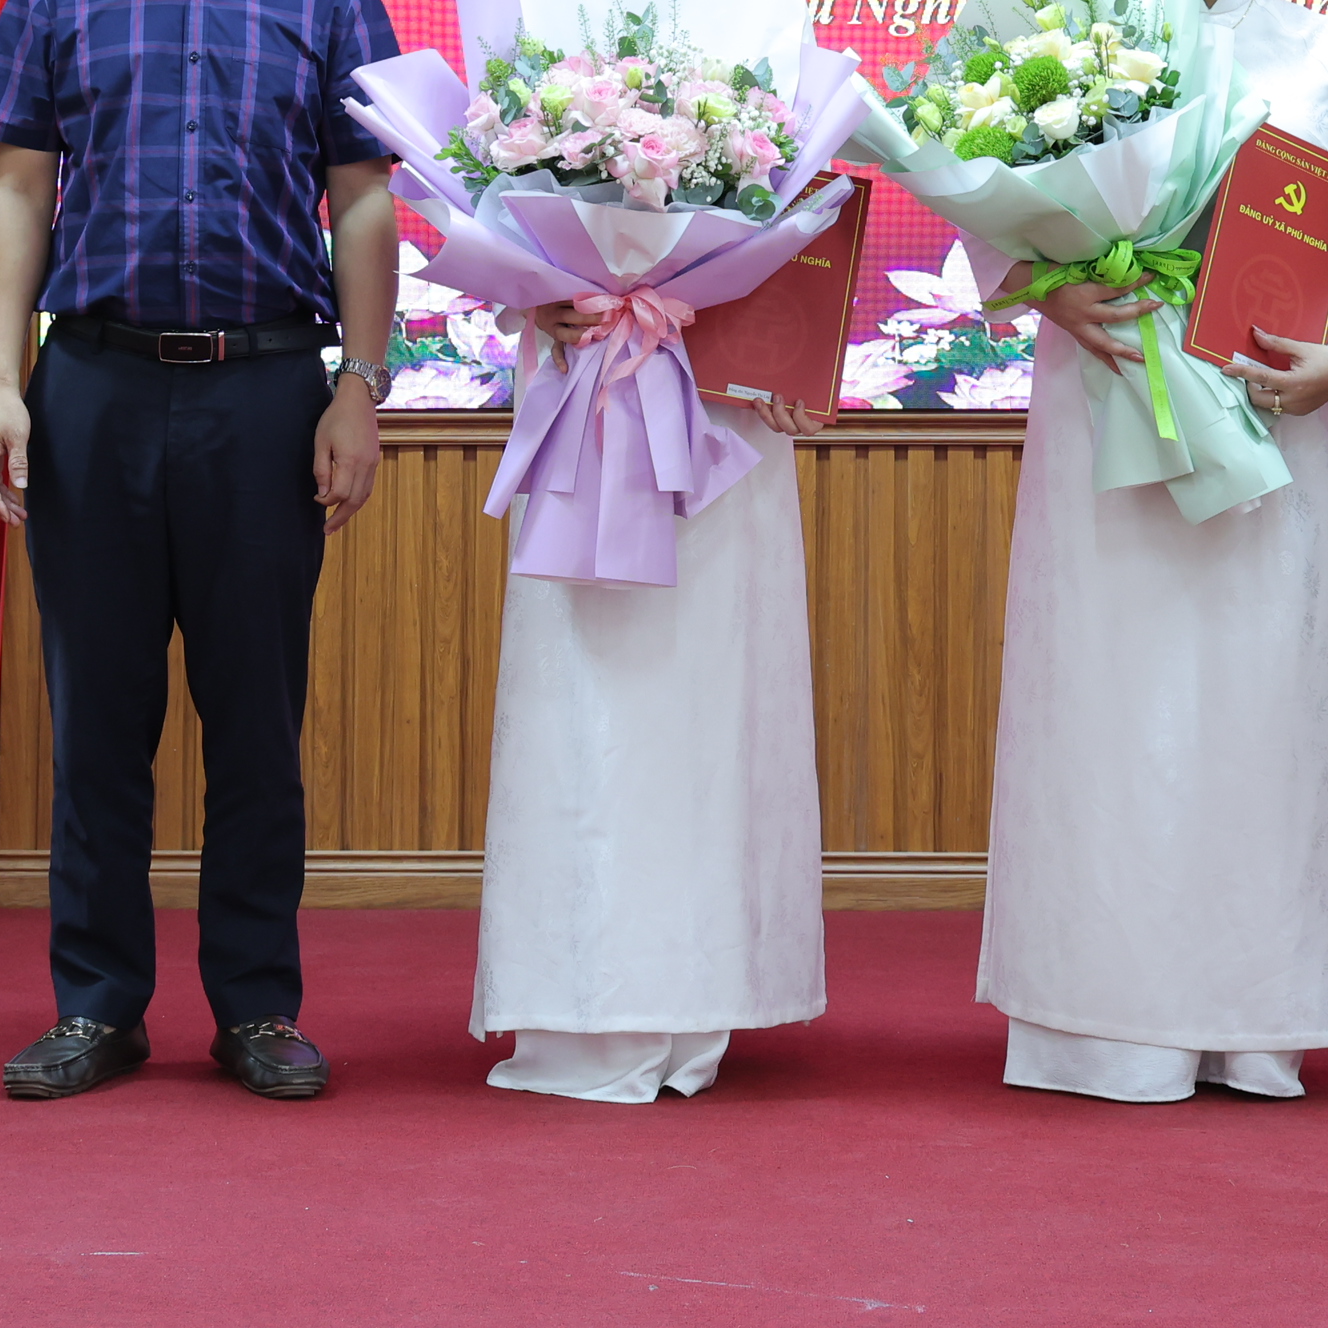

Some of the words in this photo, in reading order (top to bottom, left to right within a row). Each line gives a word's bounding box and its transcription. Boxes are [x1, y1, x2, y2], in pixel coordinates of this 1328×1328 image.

[1256, 139, 1276, 154] ĐẢNG
[1276, 149, 1296, 163] CỘNG
[1296, 158, 1310, 170] SẢN
[1310, 164, 1328, 178] VIỆT
[1239, 204, 1262, 222] ĐẢNG
[1274, 221, 1286, 233] XÃ
[1286, 226, 1303, 240] PHÚ
[1303, 234, 1328, 252] NGHĨA
[800, 255, 832, 269] NGHĨA
